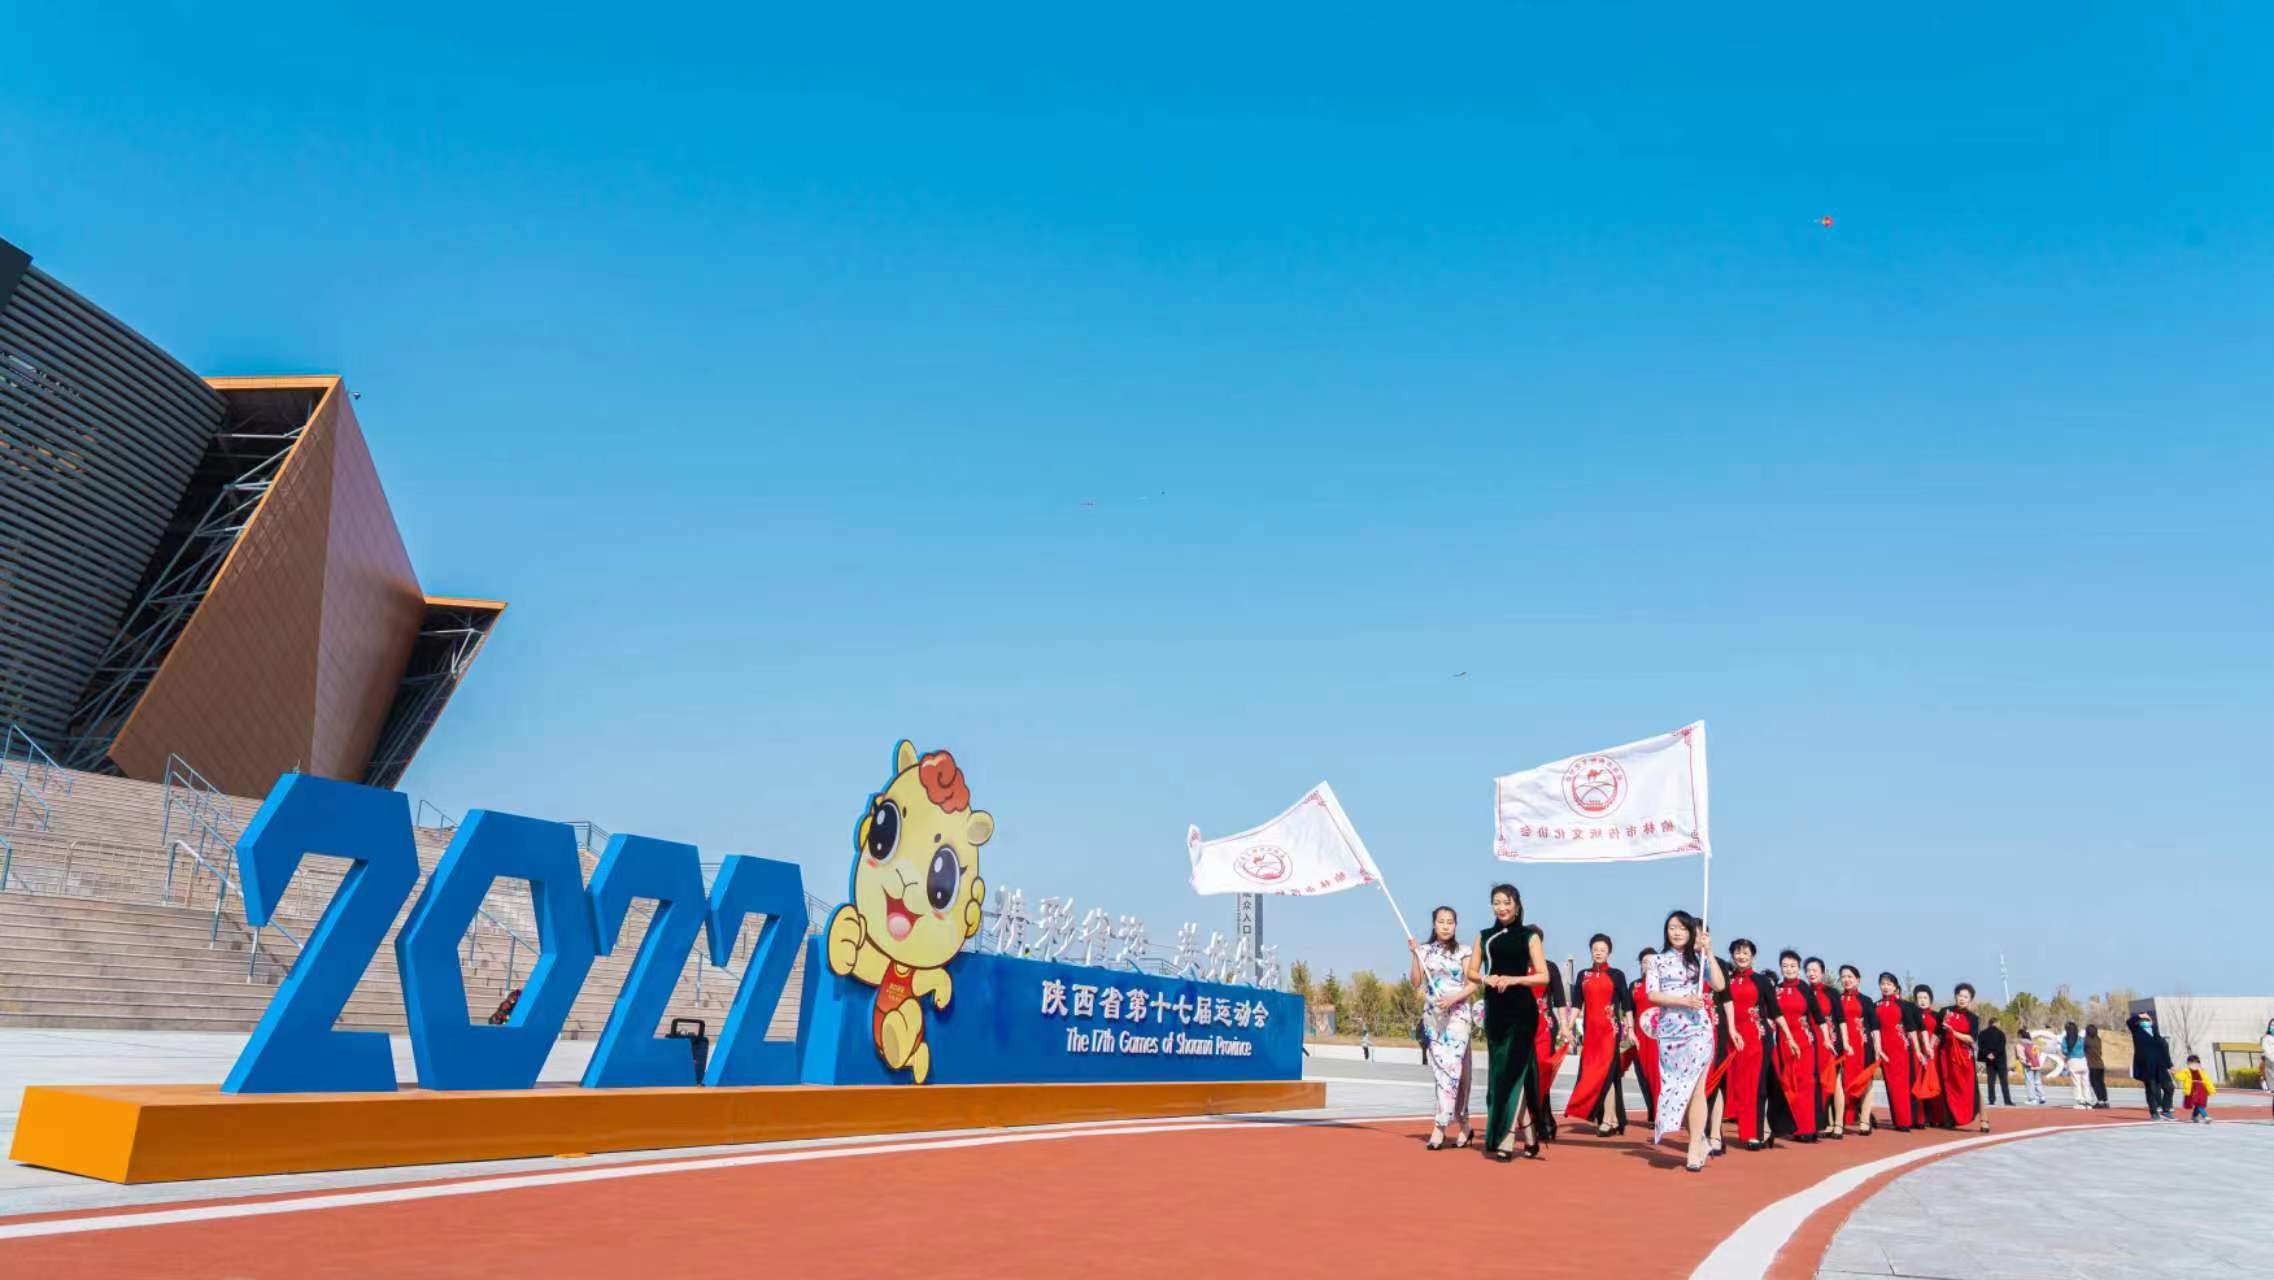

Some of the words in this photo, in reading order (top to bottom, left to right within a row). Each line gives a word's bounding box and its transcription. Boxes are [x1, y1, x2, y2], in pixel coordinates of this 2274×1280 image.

[221, 772, 809, 1093] 2022
[1041, 979, 1270, 1028] 陕西省第十七届运动会
[1066, 1027, 1090, 1052] The
[1092, 1028, 1115, 1053] 17th
[1119, 1030, 1158, 1054] Games
[1162, 1032, 1174, 1054] of
[1215, 1035, 1252, 1056] Province
